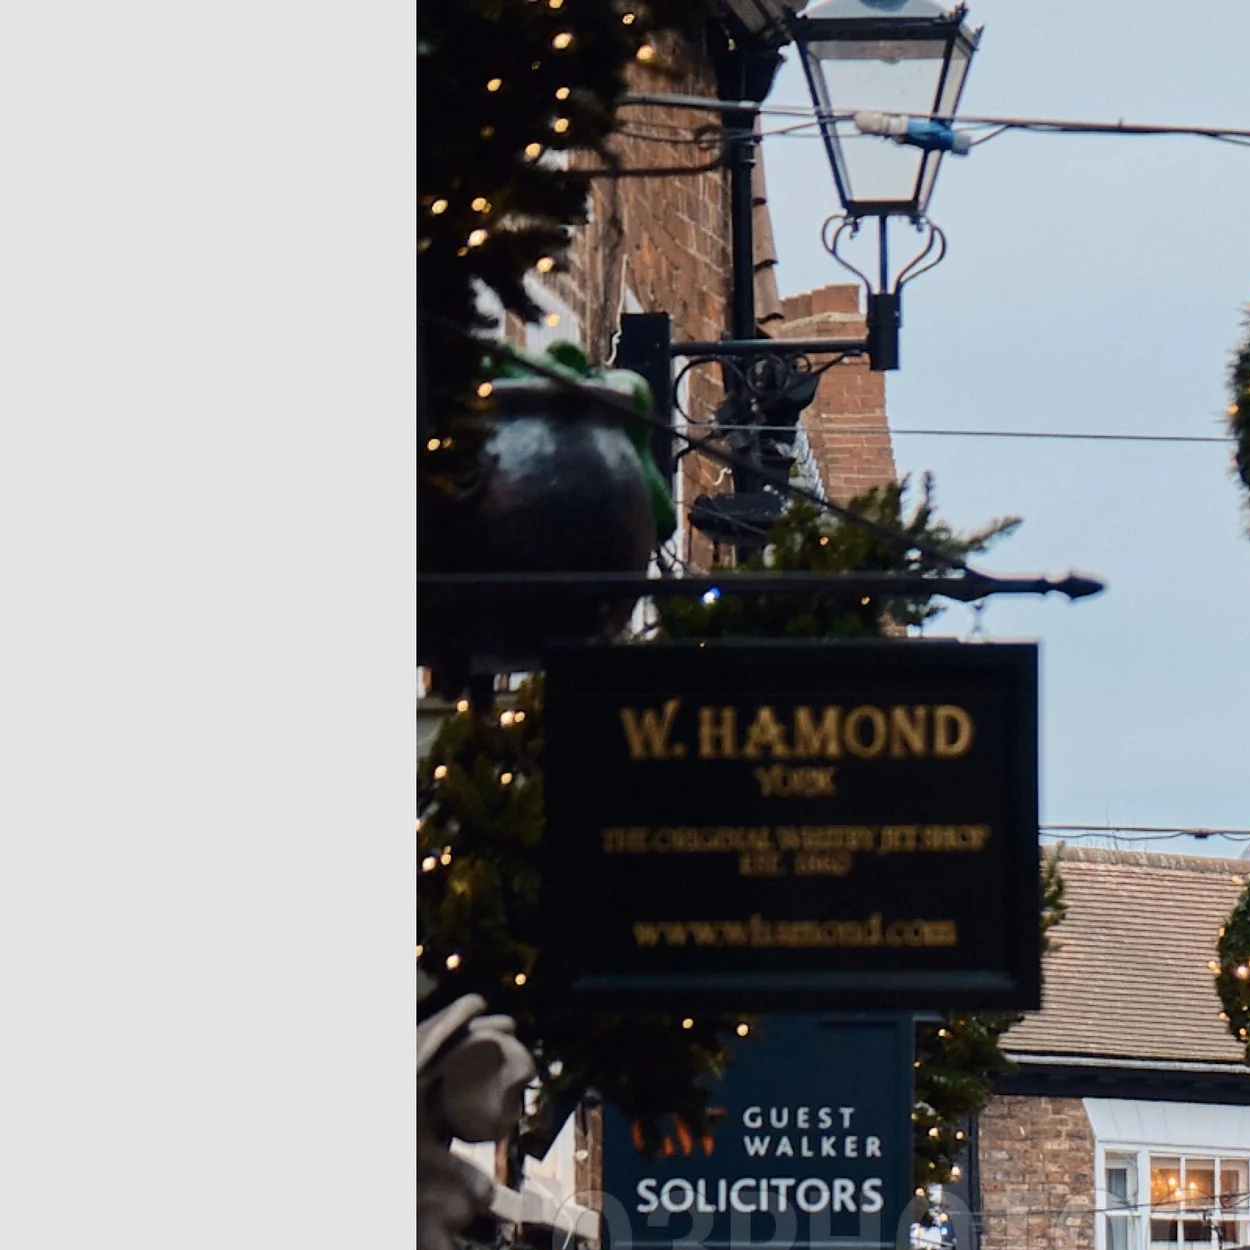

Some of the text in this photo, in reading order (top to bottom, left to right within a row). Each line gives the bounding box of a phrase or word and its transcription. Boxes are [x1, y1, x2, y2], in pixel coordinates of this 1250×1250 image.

[620, 699, 974, 760] W. HAMOND
[754, 766, 837, 796] YORK
[743, 1106, 856, 1130] GUEST
[743, 1135, 882, 1158] WALKER
[636, 1177, 885, 1214] SOLICITORS
